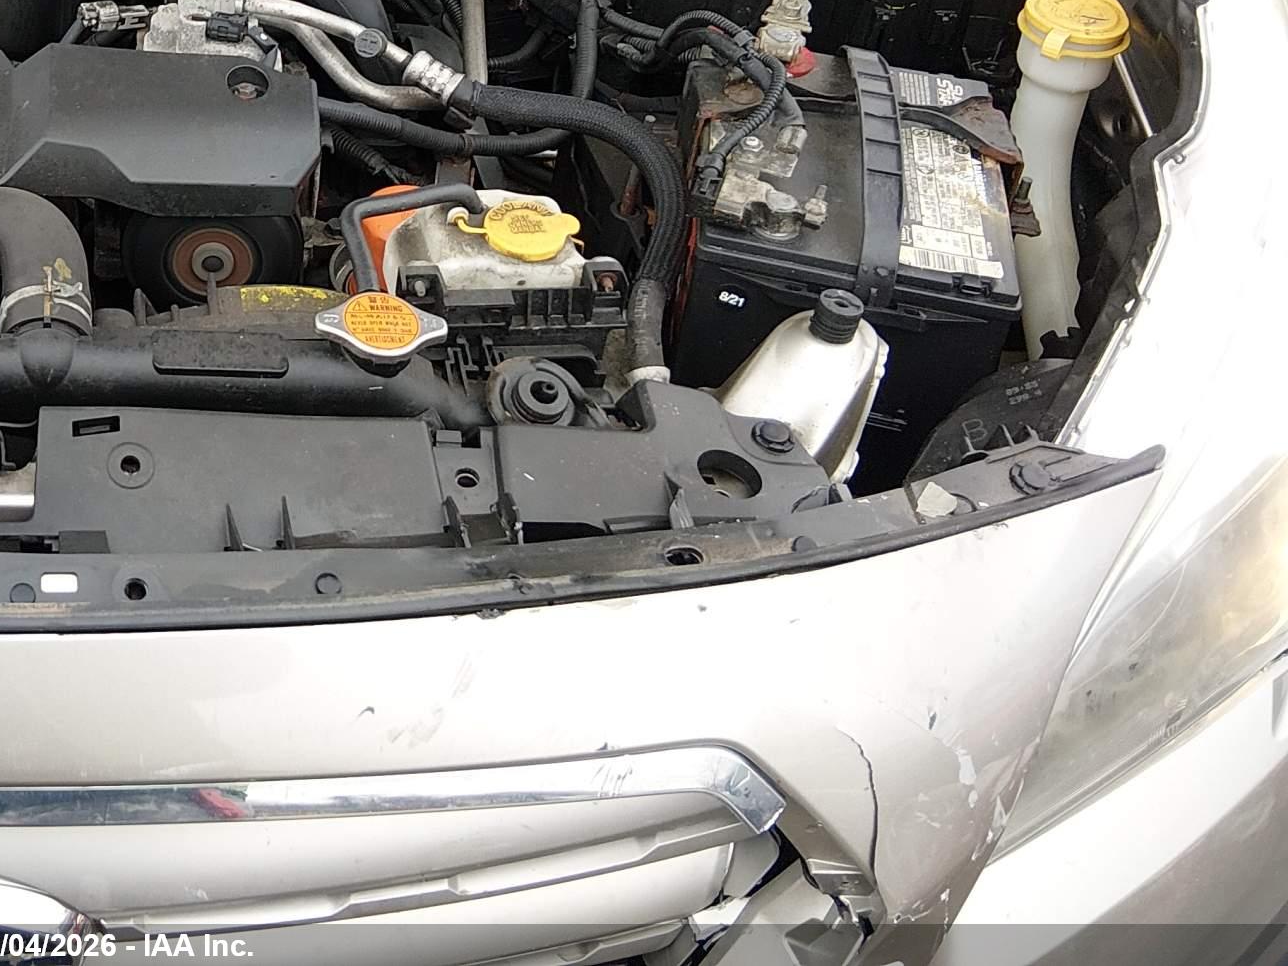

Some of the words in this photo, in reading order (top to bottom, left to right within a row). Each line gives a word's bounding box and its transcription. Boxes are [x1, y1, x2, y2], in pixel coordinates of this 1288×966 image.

[489, 201, 555, 222] COOLANT
[718, 290, 745, 308] 8/21
[369, 304, 404, 313] WARNING
